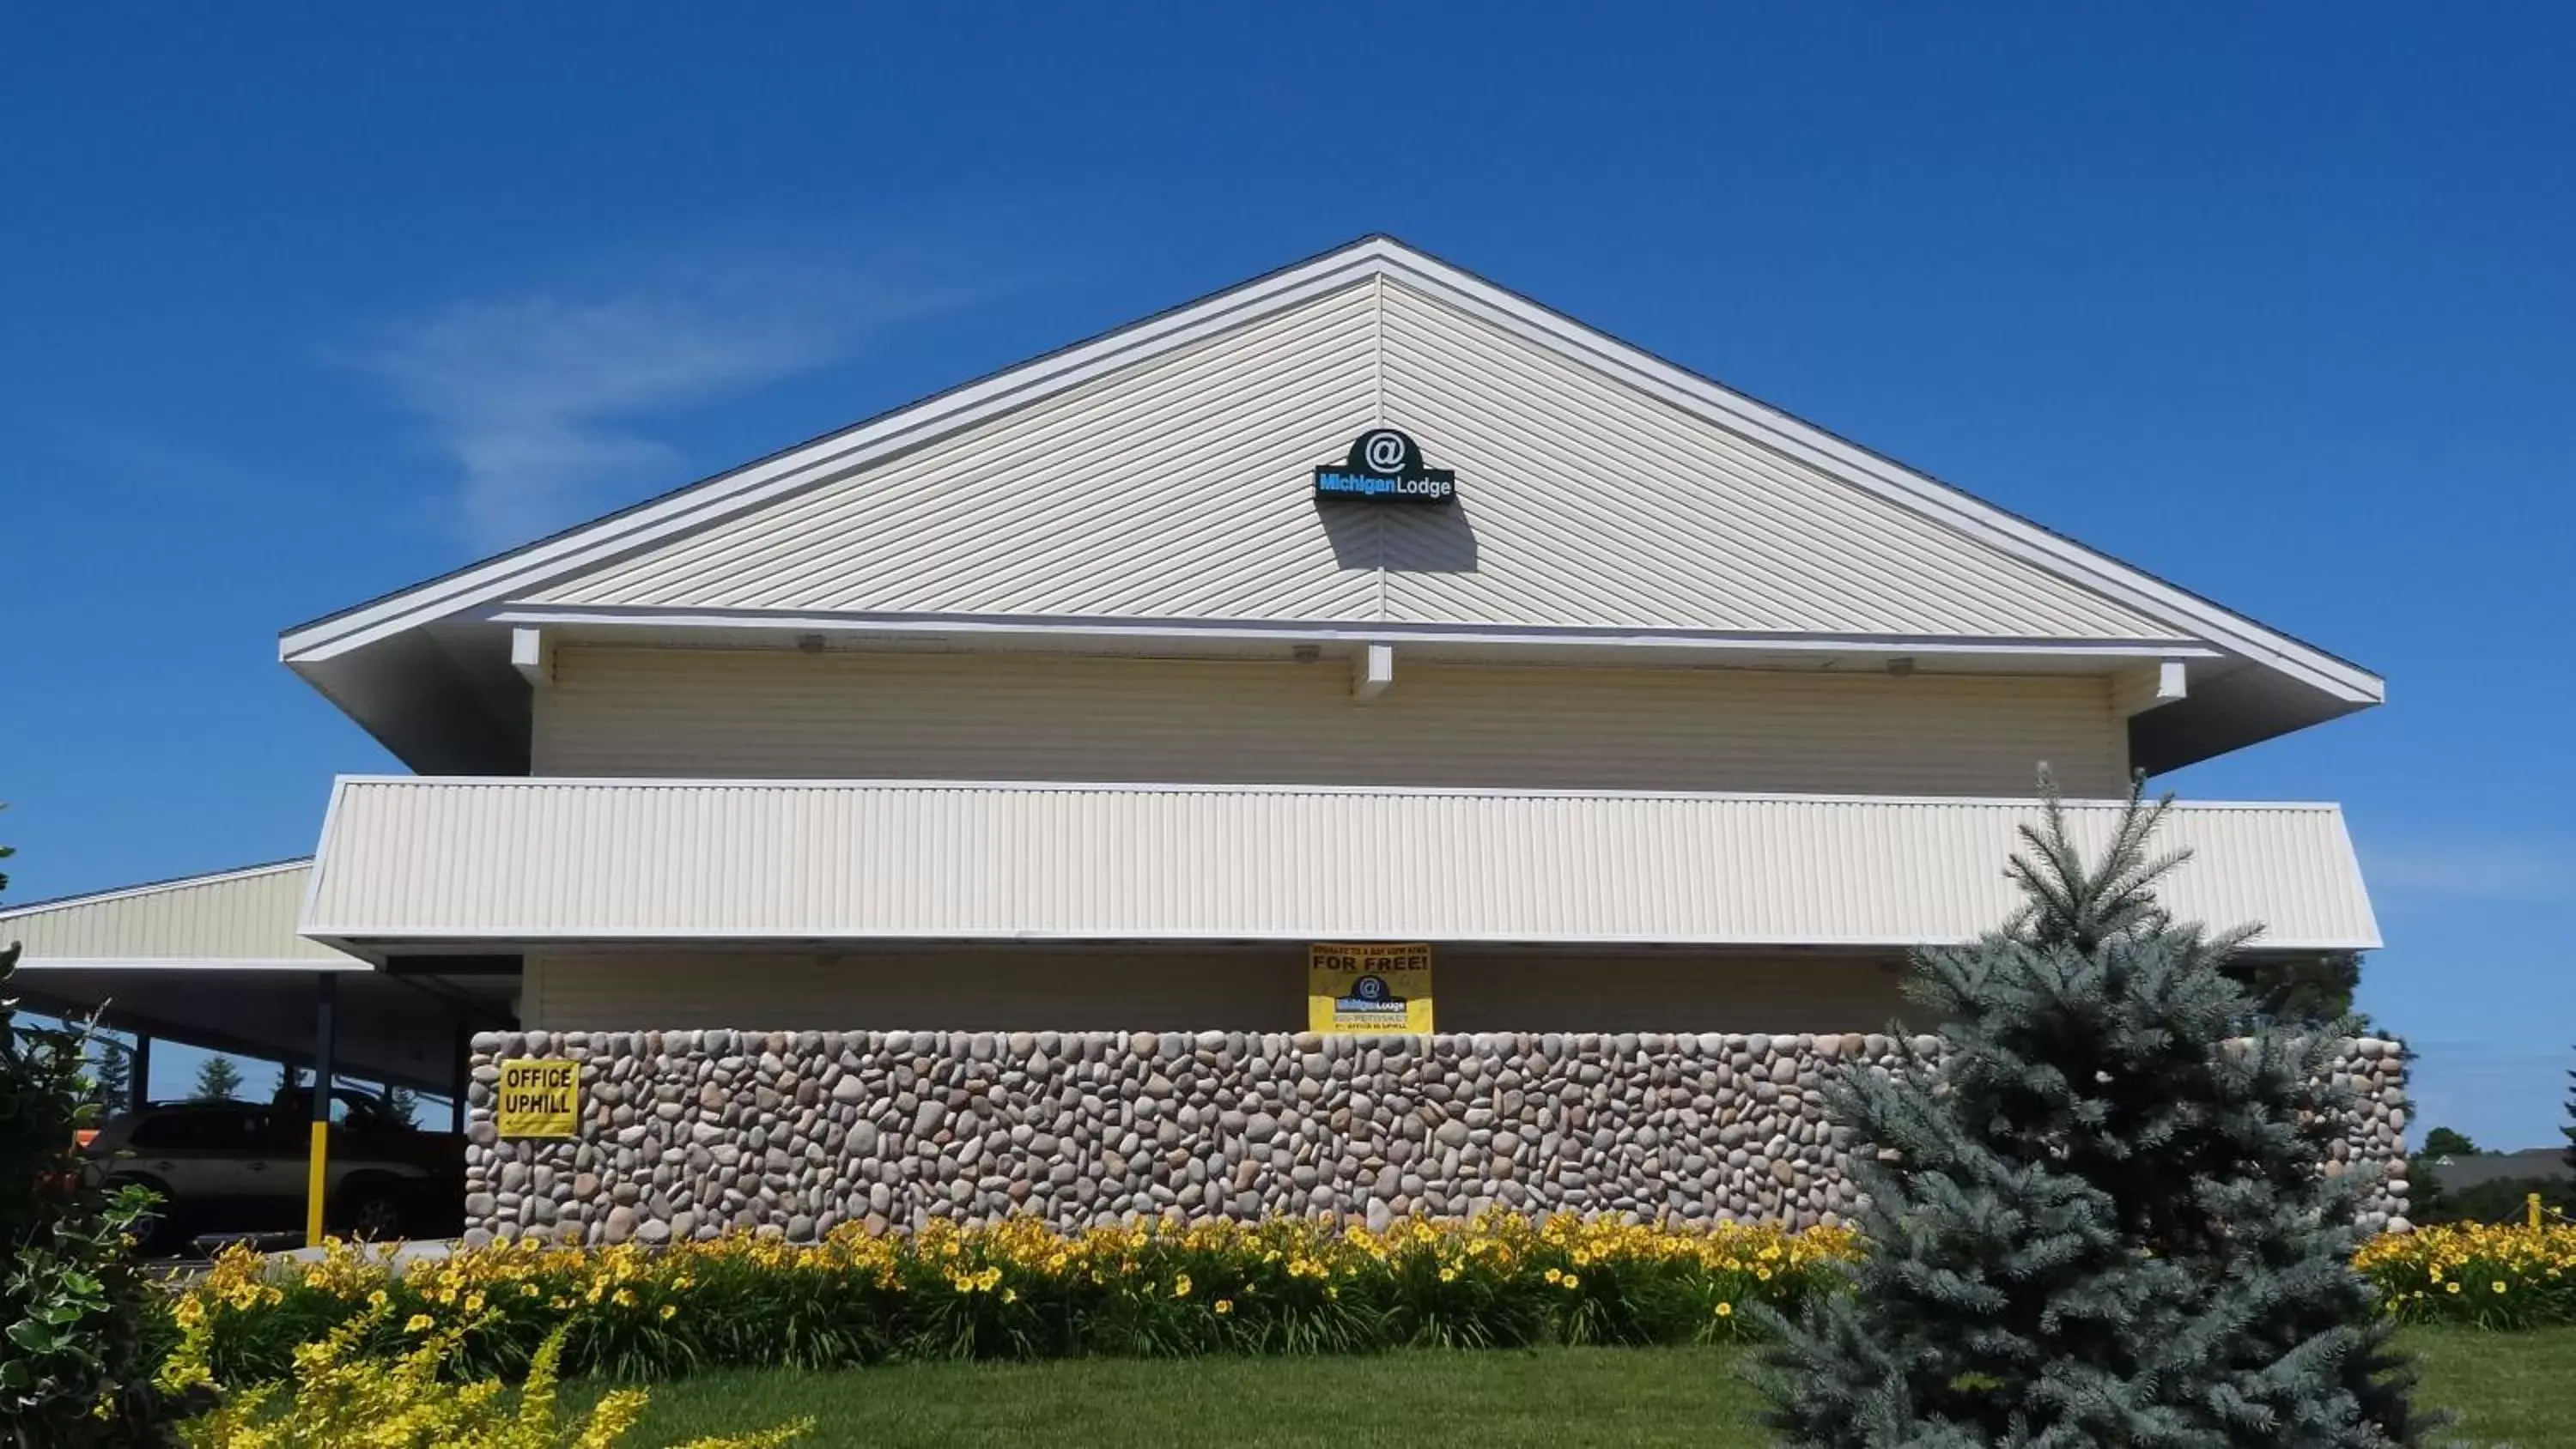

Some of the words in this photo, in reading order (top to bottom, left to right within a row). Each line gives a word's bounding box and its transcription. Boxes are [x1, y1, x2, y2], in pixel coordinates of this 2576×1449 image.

[1314, 955, 1357, 969] FOR
[1364, 955, 1428, 970] FREE!
[507, 1069, 571, 1088] OFFICE
[506, 1094, 570, 1113] UPHILL
